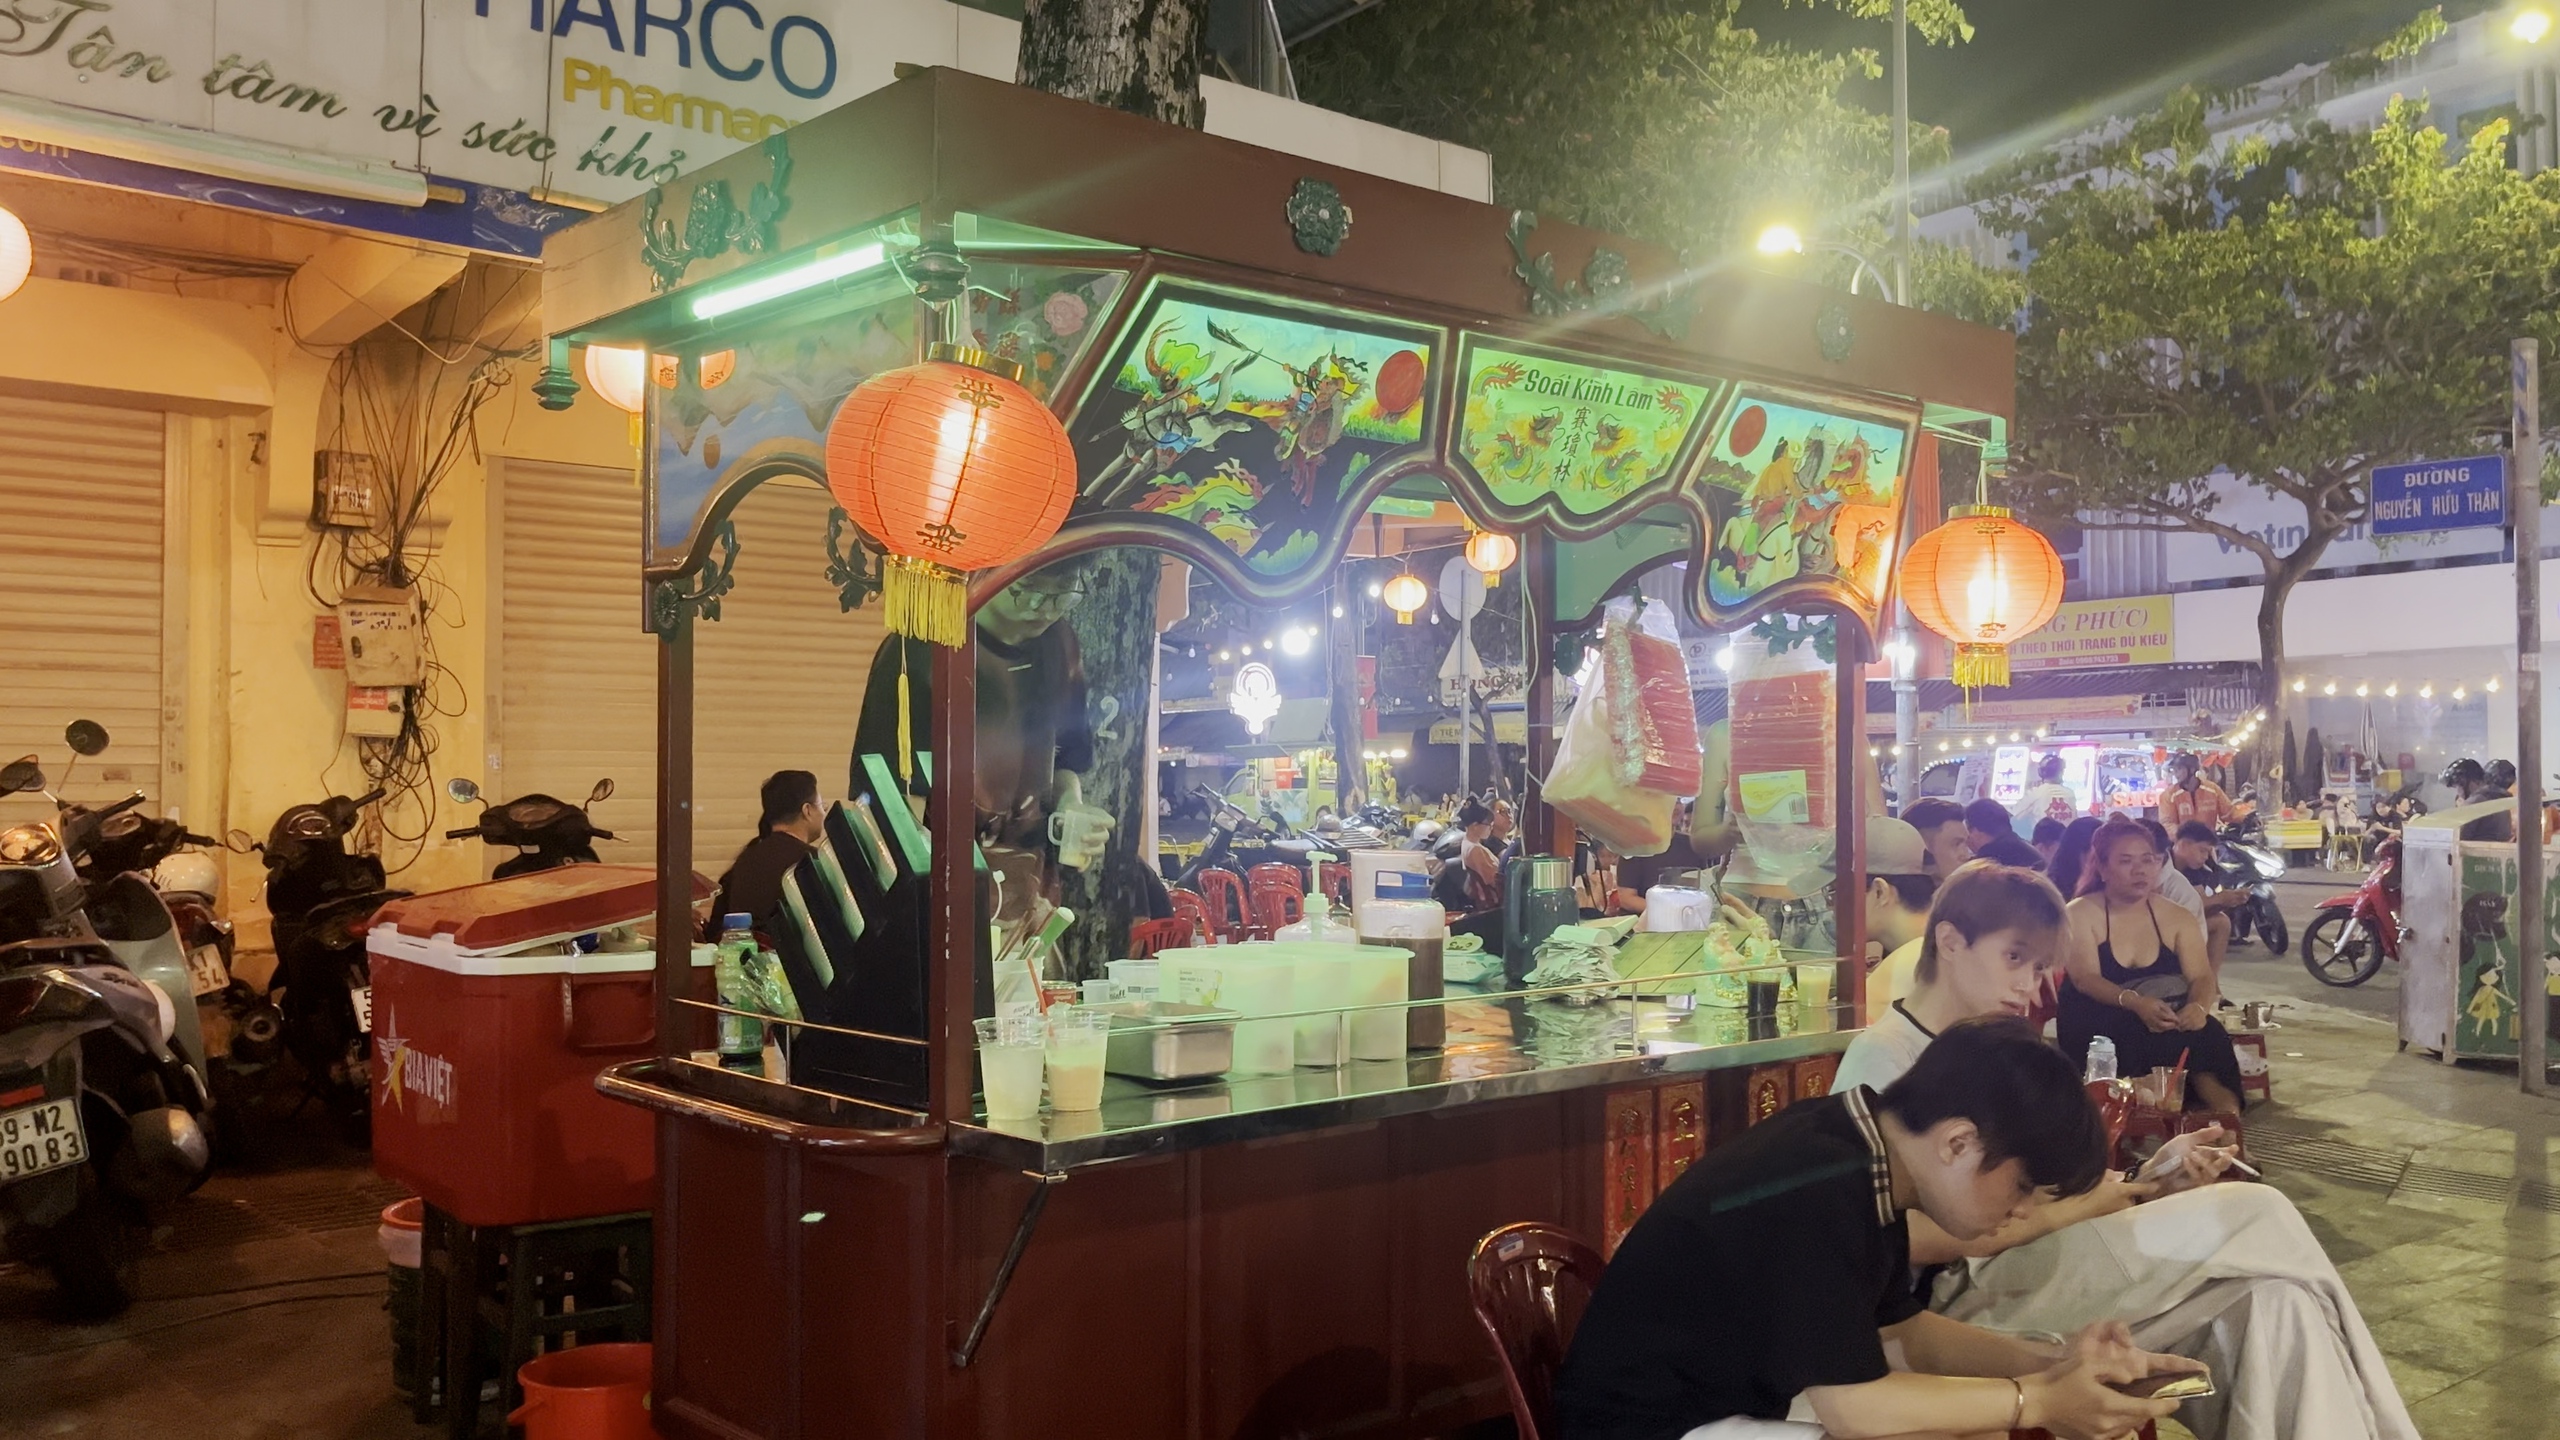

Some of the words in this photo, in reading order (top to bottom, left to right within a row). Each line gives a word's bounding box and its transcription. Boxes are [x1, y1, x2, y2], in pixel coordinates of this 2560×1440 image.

[474, 0, 838, 99] ARCO
[202, 54, 348, 118] tâm
[373, 94, 442, 138] vì
[1525, 369, 1571, 397] Soái
[1614, 385, 1653, 411] Lâm
[2403, 466, 2470, 488] ĐƯỜNG
[2374, 491, 2422, 521] NGUYỄN
[2080, 636, 2116, 650] TRANG
[1097, 695, 1120, 740] 2
[0, 1131, 80, 1178] 90.83
